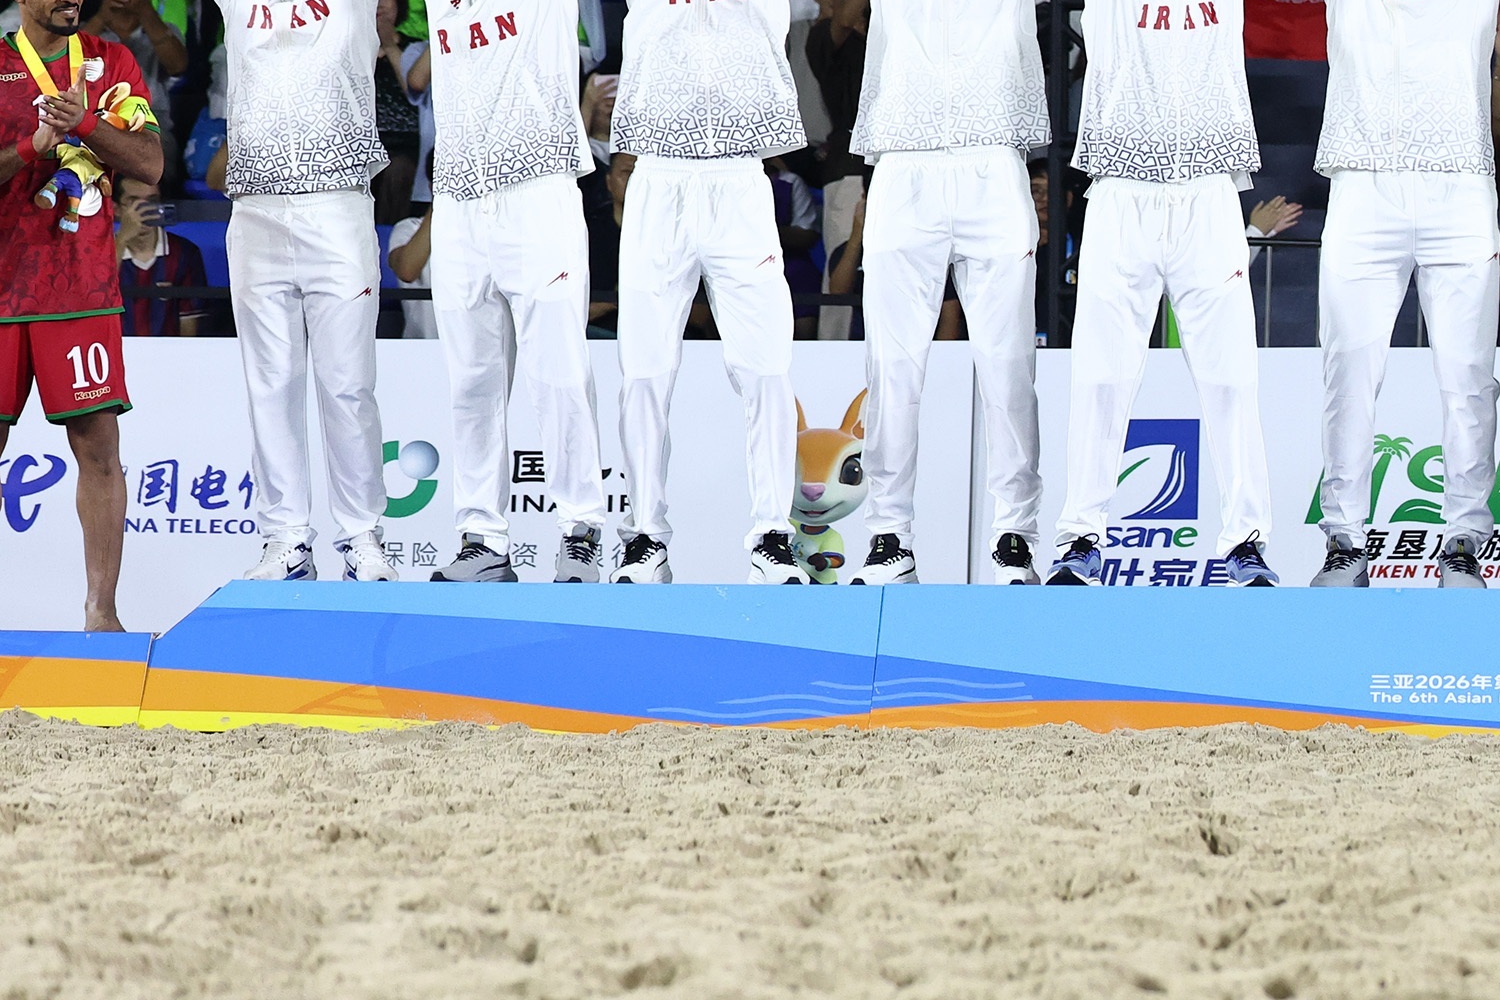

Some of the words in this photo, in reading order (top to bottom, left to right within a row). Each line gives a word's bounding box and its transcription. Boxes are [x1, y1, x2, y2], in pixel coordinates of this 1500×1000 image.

[66, 342, 110, 389] 10
[74, 386, 111, 401] Kappa
[166, 517, 261, 535] TELECO
[1370, 692, 1403, 704] The
[1409, 692, 1437, 704] 6th
[1444, 692, 1492, 704] Asian
